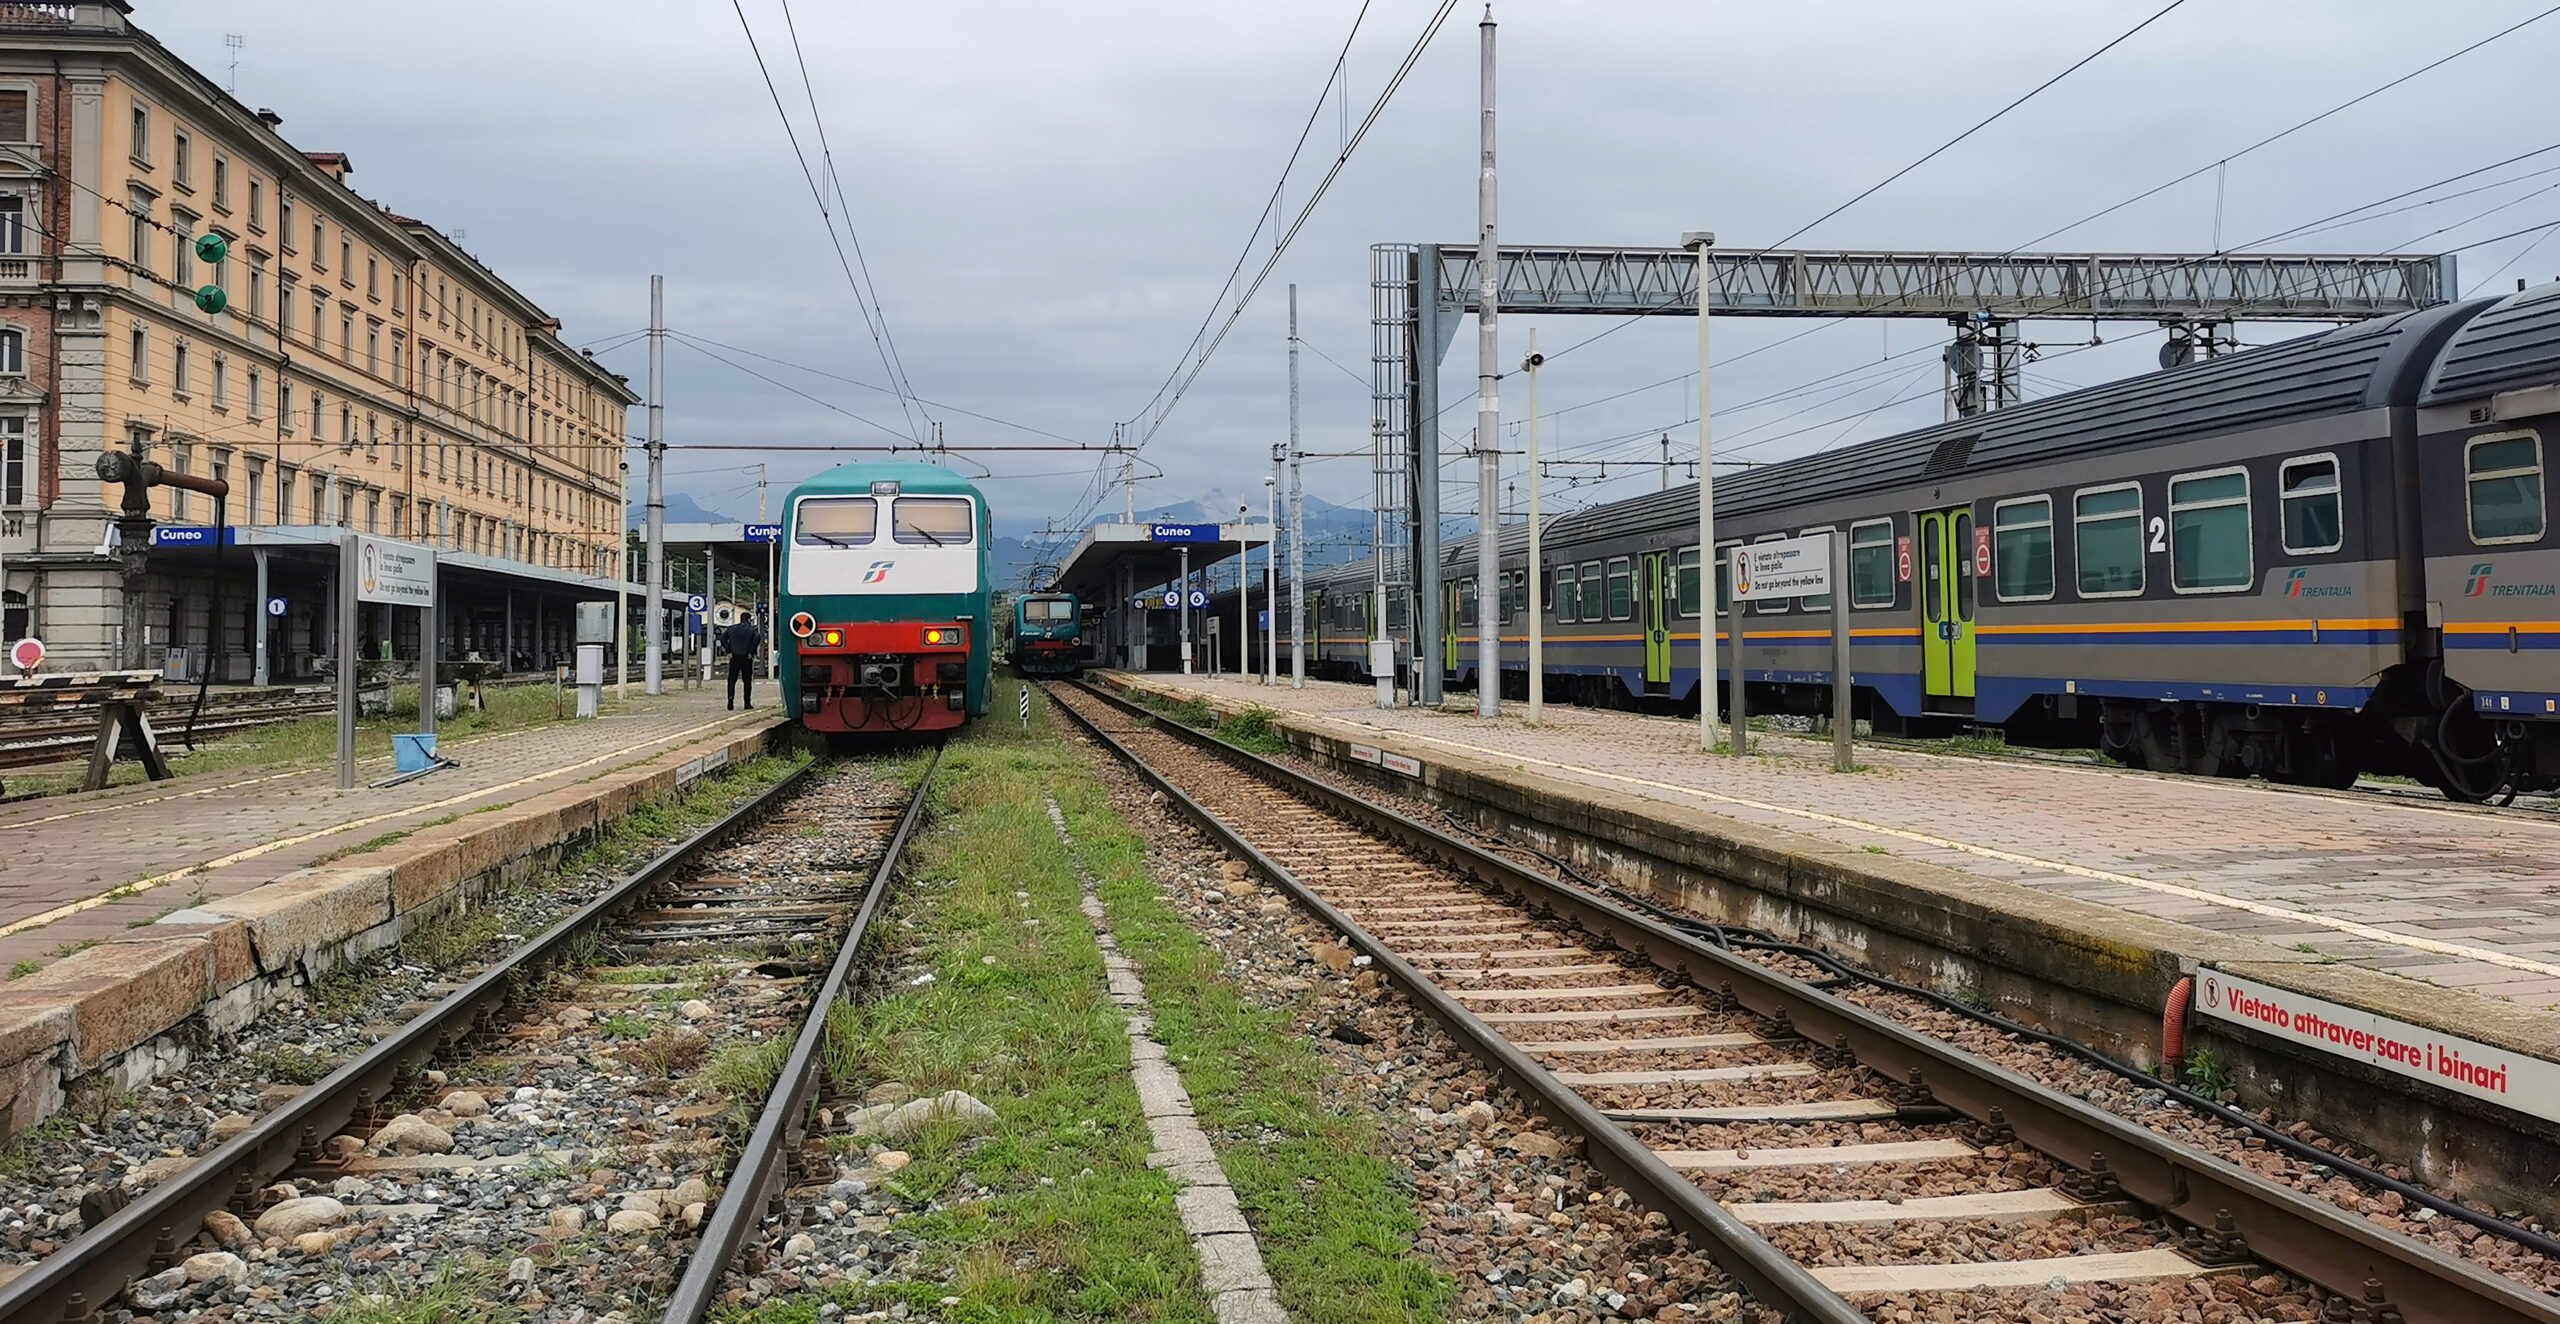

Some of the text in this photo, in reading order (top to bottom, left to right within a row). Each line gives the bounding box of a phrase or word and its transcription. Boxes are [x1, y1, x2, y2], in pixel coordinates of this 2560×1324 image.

[160, 529, 202, 540] Cuneo
[1155, 526, 1191, 536] Cuneo
[2149, 516, 2166, 553] 2
[1576, 582, 1581, 601] 2
[2301, 585, 2352, 598] TRENITALIA
[2492, 584, 2556, 597] TRENITALIA
[2227, 986, 2289, 1028] Vietato
[2427, 1043, 2433, 1071] i
[2439, 1045, 2507, 1093] binari
